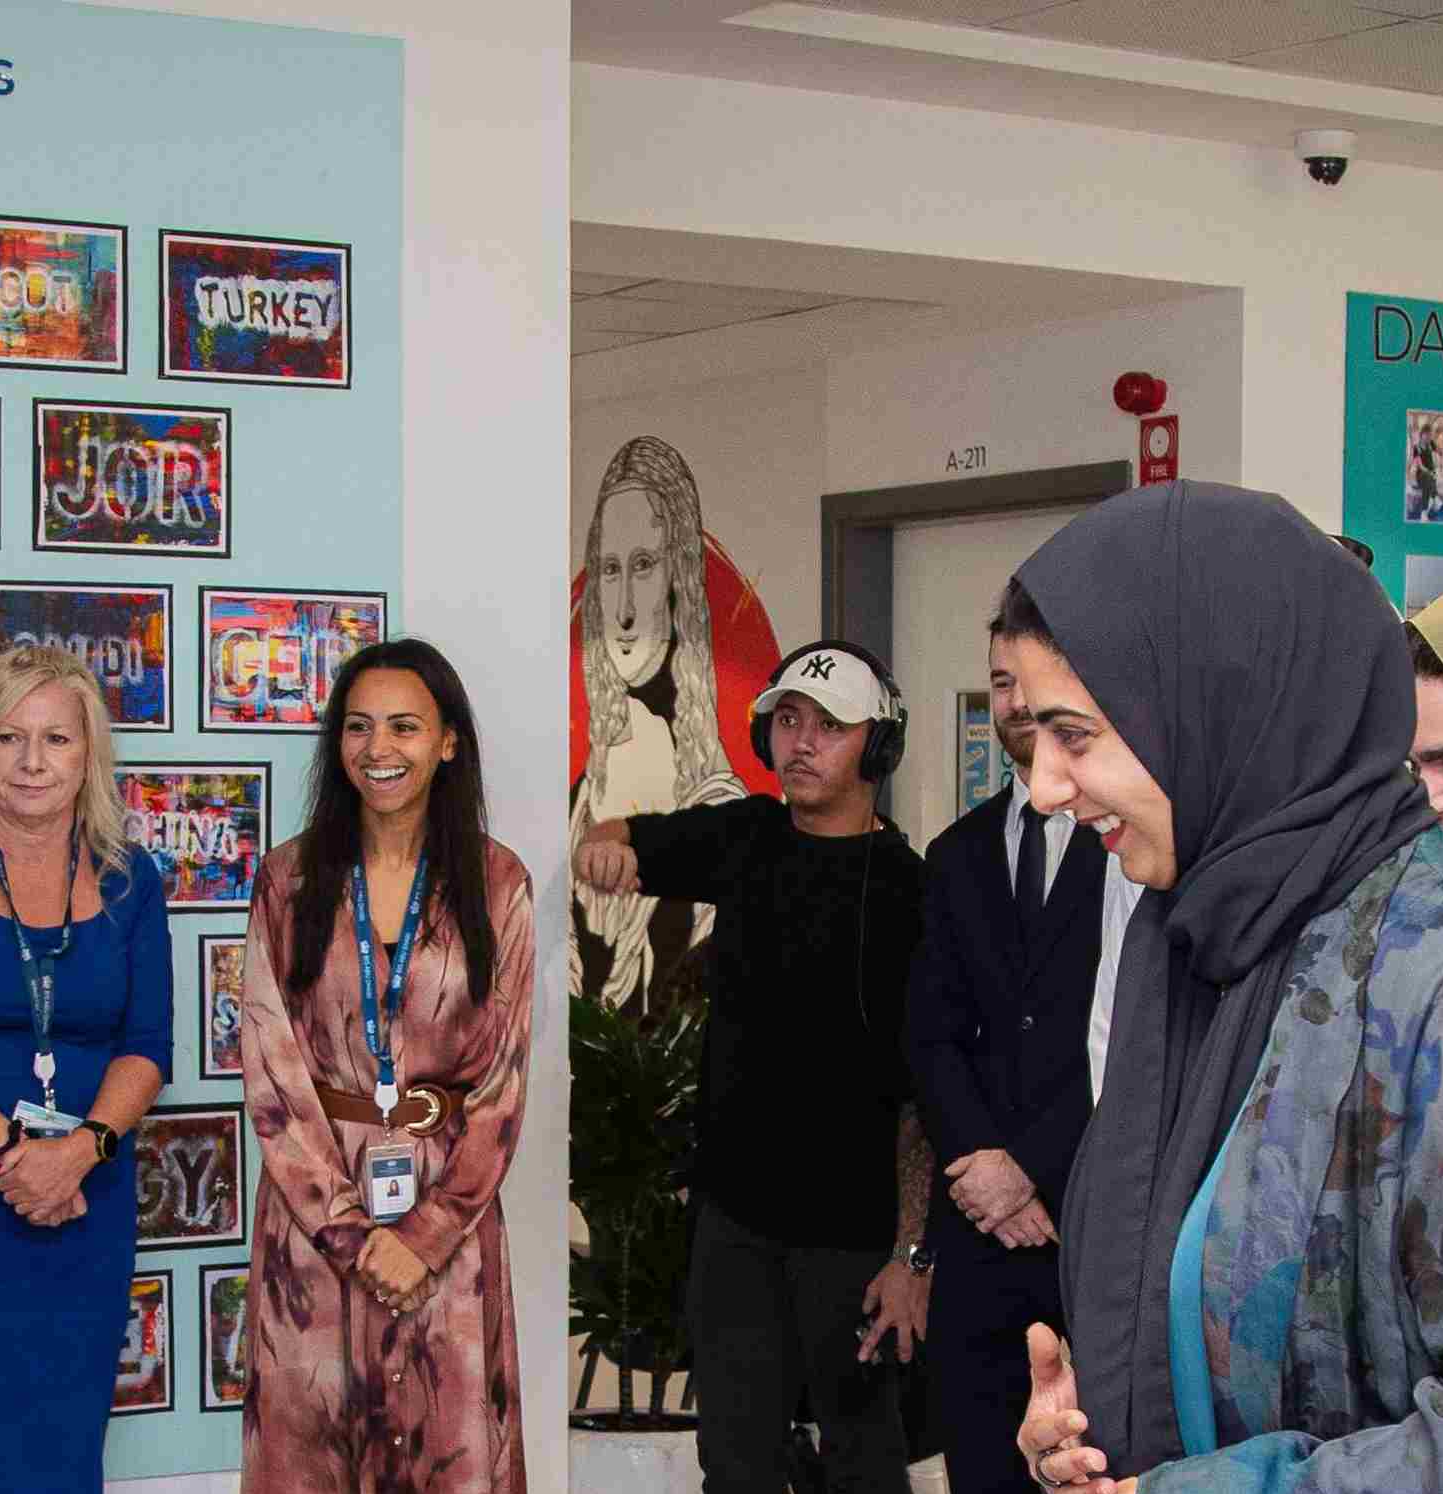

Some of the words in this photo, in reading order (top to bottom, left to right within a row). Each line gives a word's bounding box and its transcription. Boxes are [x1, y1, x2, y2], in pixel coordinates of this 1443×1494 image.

[198, 277, 335, 334] TURKEY
[53, 438, 210, 528] JOR
[945, 446, 987, 472] A-211
